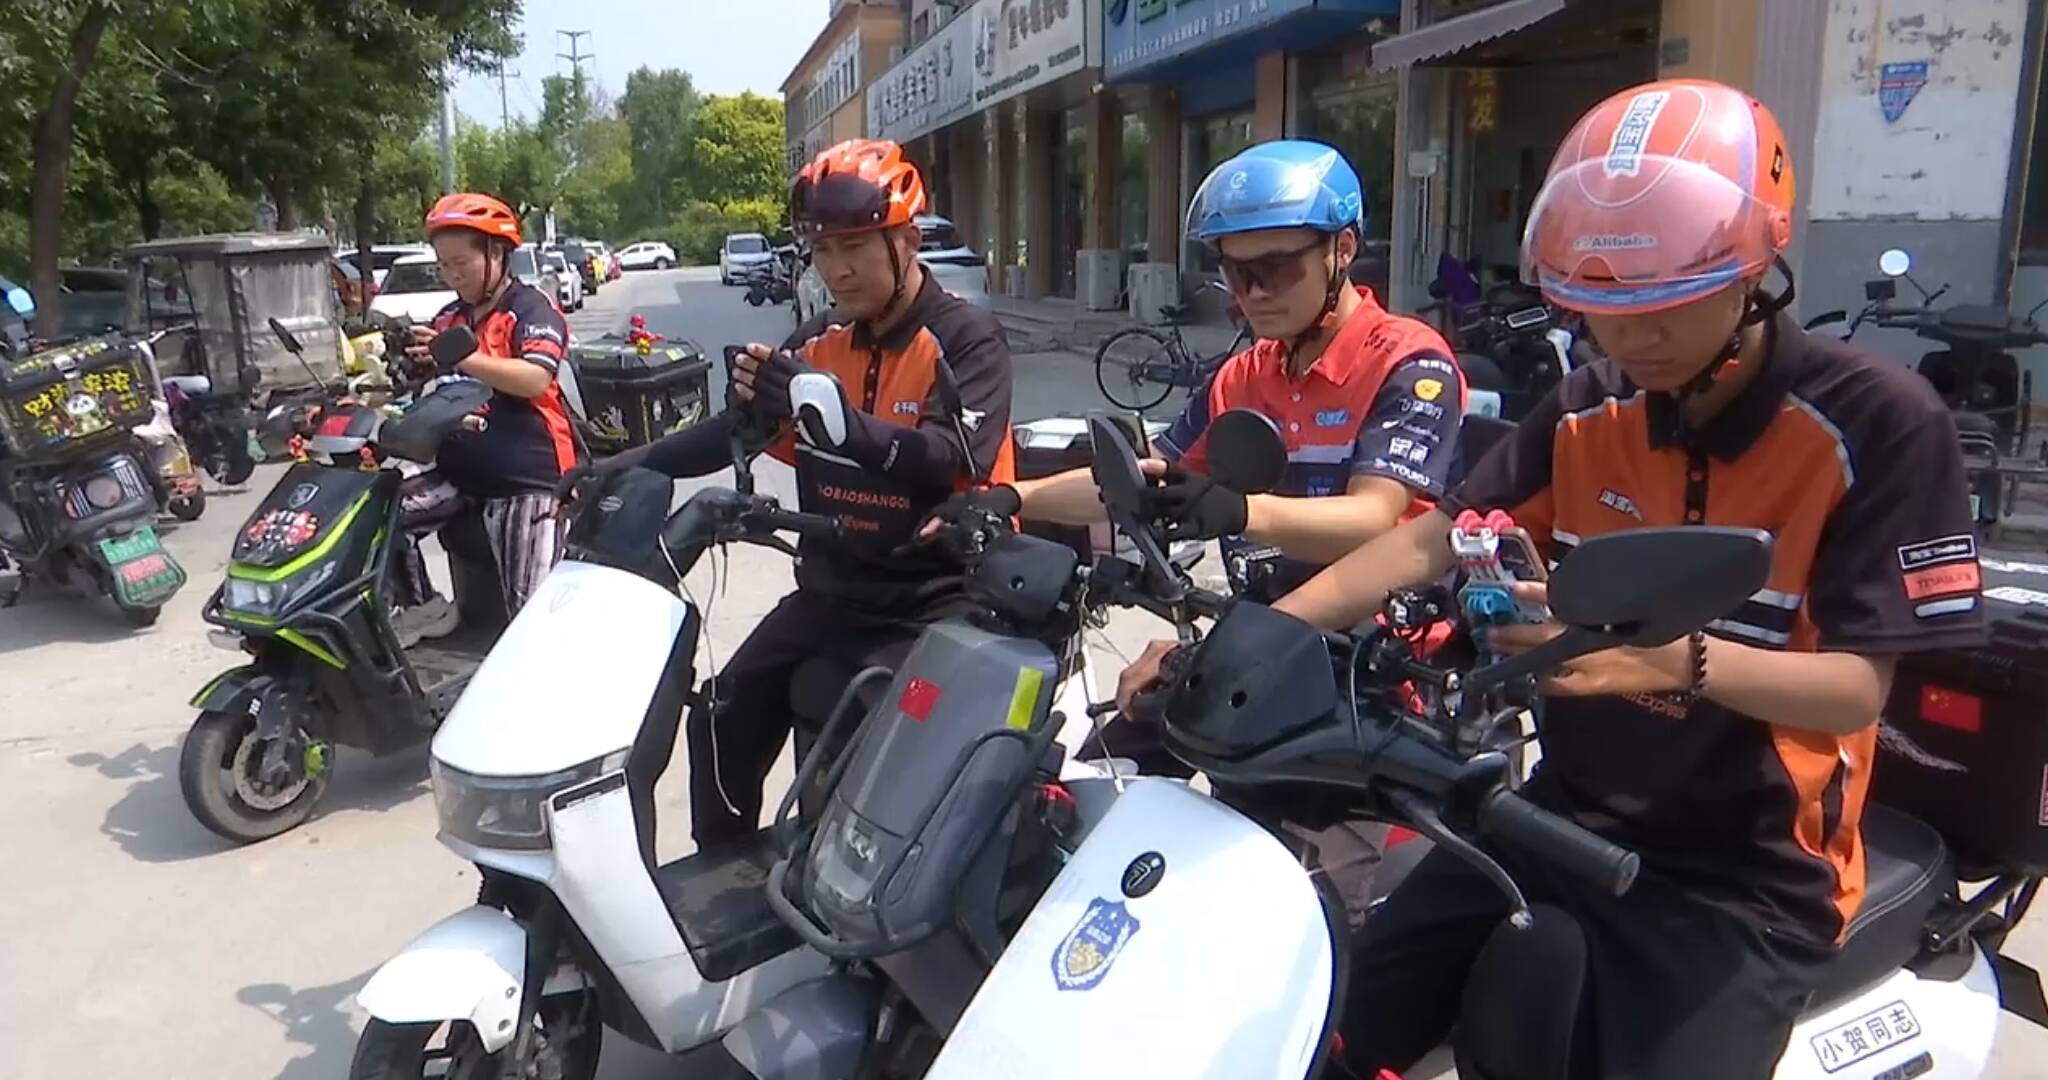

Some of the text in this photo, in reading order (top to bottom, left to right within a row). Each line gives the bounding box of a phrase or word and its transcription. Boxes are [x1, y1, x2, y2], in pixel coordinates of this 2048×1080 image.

[1591, 235, 1654, 249] Alibaba
[1822, 1008, 1914, 1064] 小贺同志
